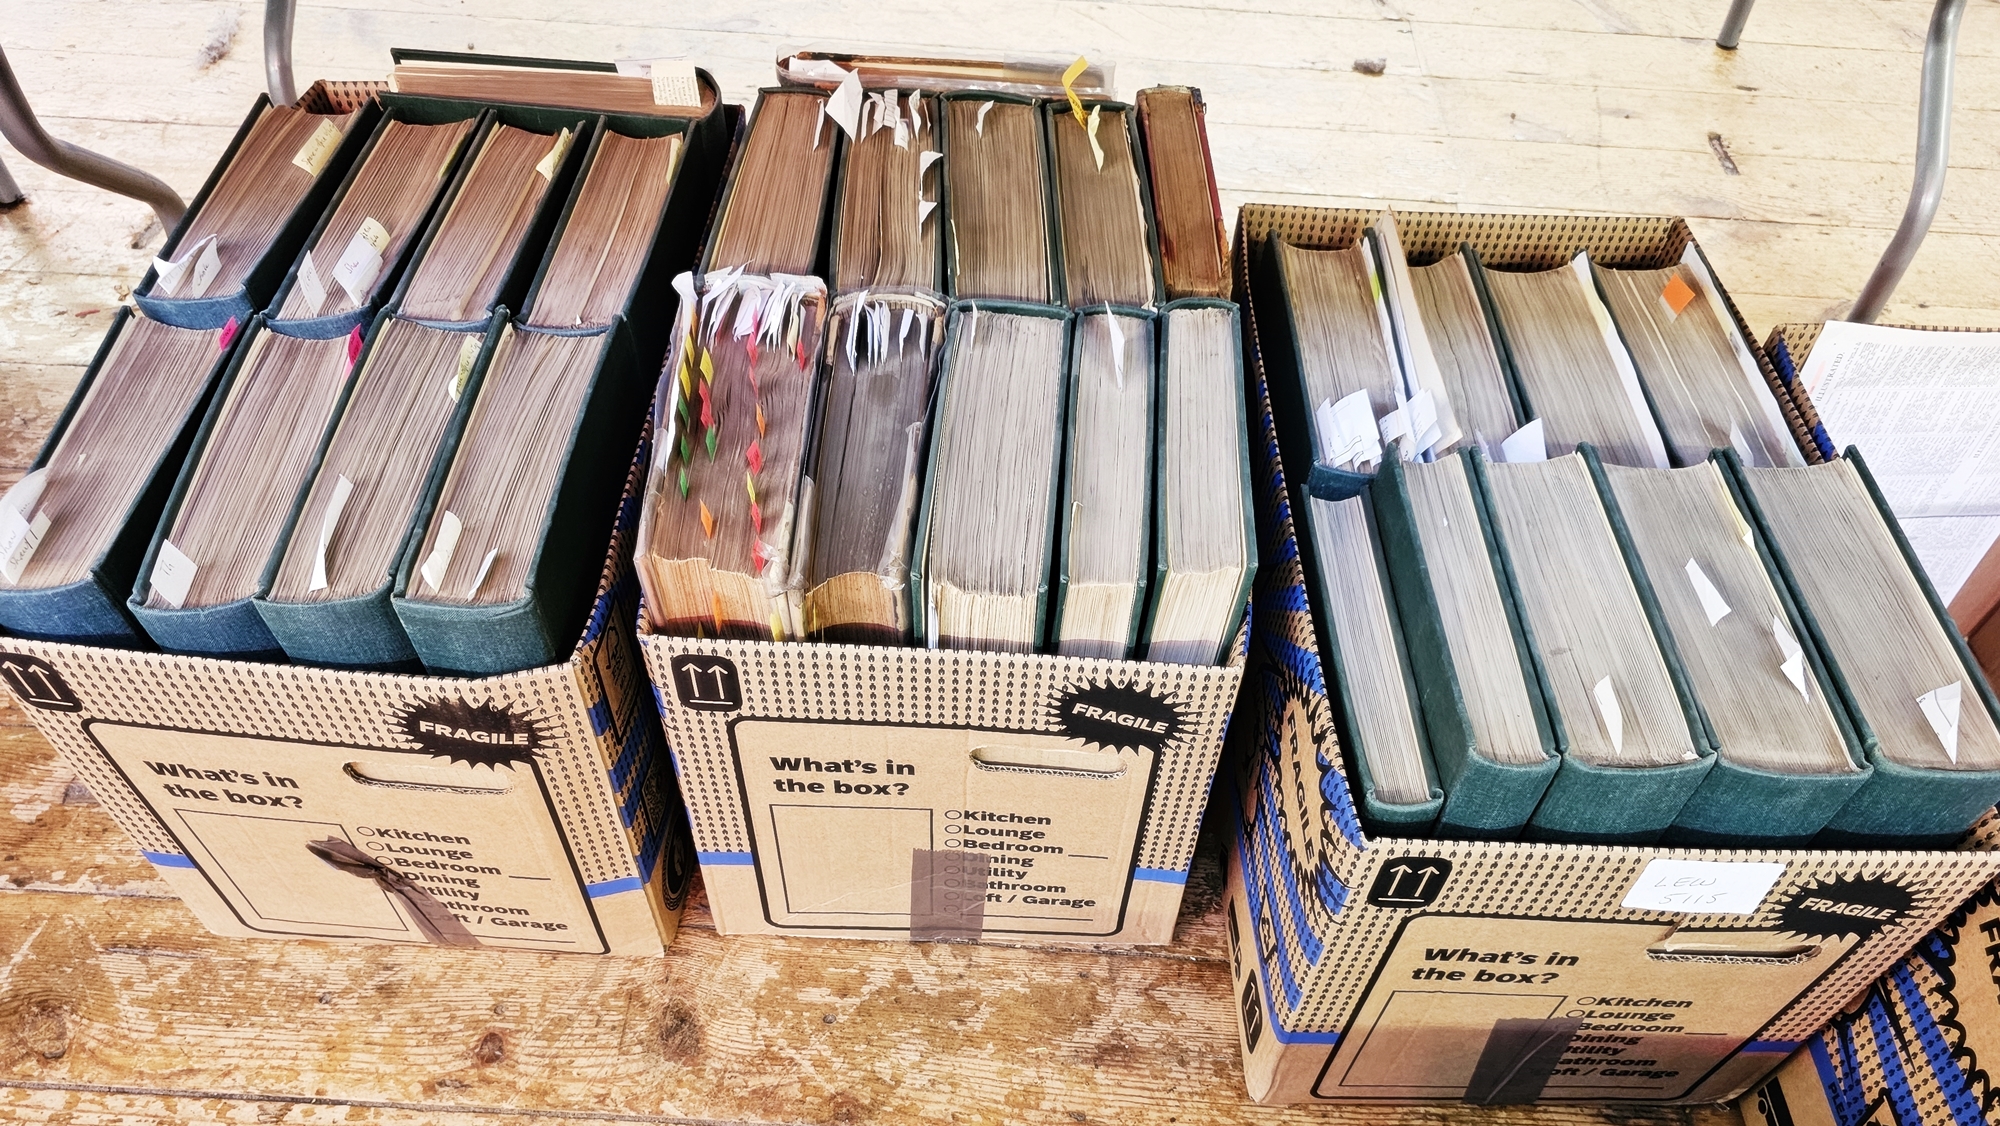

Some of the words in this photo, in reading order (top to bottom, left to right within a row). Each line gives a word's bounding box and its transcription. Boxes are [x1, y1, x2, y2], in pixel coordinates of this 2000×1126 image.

[1072, 702, 1169, 734] FRAGILE
[419, 720, 529, 745] FRAGILE
[143, 760, 260, 785] What's
[262, 771, 300, 789] in
[769, 756, 878, 774] What's
[885, 759, 915, 776] in
[773, 778, 825, 793] the
[833, 780, 909, 796] box?
[1287, 709, 1315, 865] FRAGILE
[162, 783, 220, 801] the
[222, 788, 303, 809] box?
[963, 810, 1052, 826] Kitchen
[375, 828, 471, 846] Kitchen
[963, 825, 1046, 840] Lounge
[385, 842, 474, 861] Lounge
[963, 838, 1064, 854] Bedroom
[393, 857, 502, 876] Bedroom
[403, 872, 481, 889] Dining
[1654, 876, 1717, 888] LEW
[1007, 894, 1017, 904] /
[1022, 895, 1097, 909] Garage
[1798, 897, 1897, 921] FRAGILE
[476, 915, 484, 925] /
[490, 917, 569, 932] Garage
[1425, 947, 1539, 965] What's
[1544, 951, 1580, 967] in
[1411, 967, 1466, 981] the
[1473, 969, 1560, 984] box?
[1595, 997, 1693, 1008] Kitchen
[1584, 1010, 1676, 1022] Lounge
[1577, 1022, 1685, 1033] Bedroom
[1559, 1056, 1657, 1067] athroom
[1550, 1067, 1580, 1077] oft
[1600, 1068, 1680, 1079] Garage
